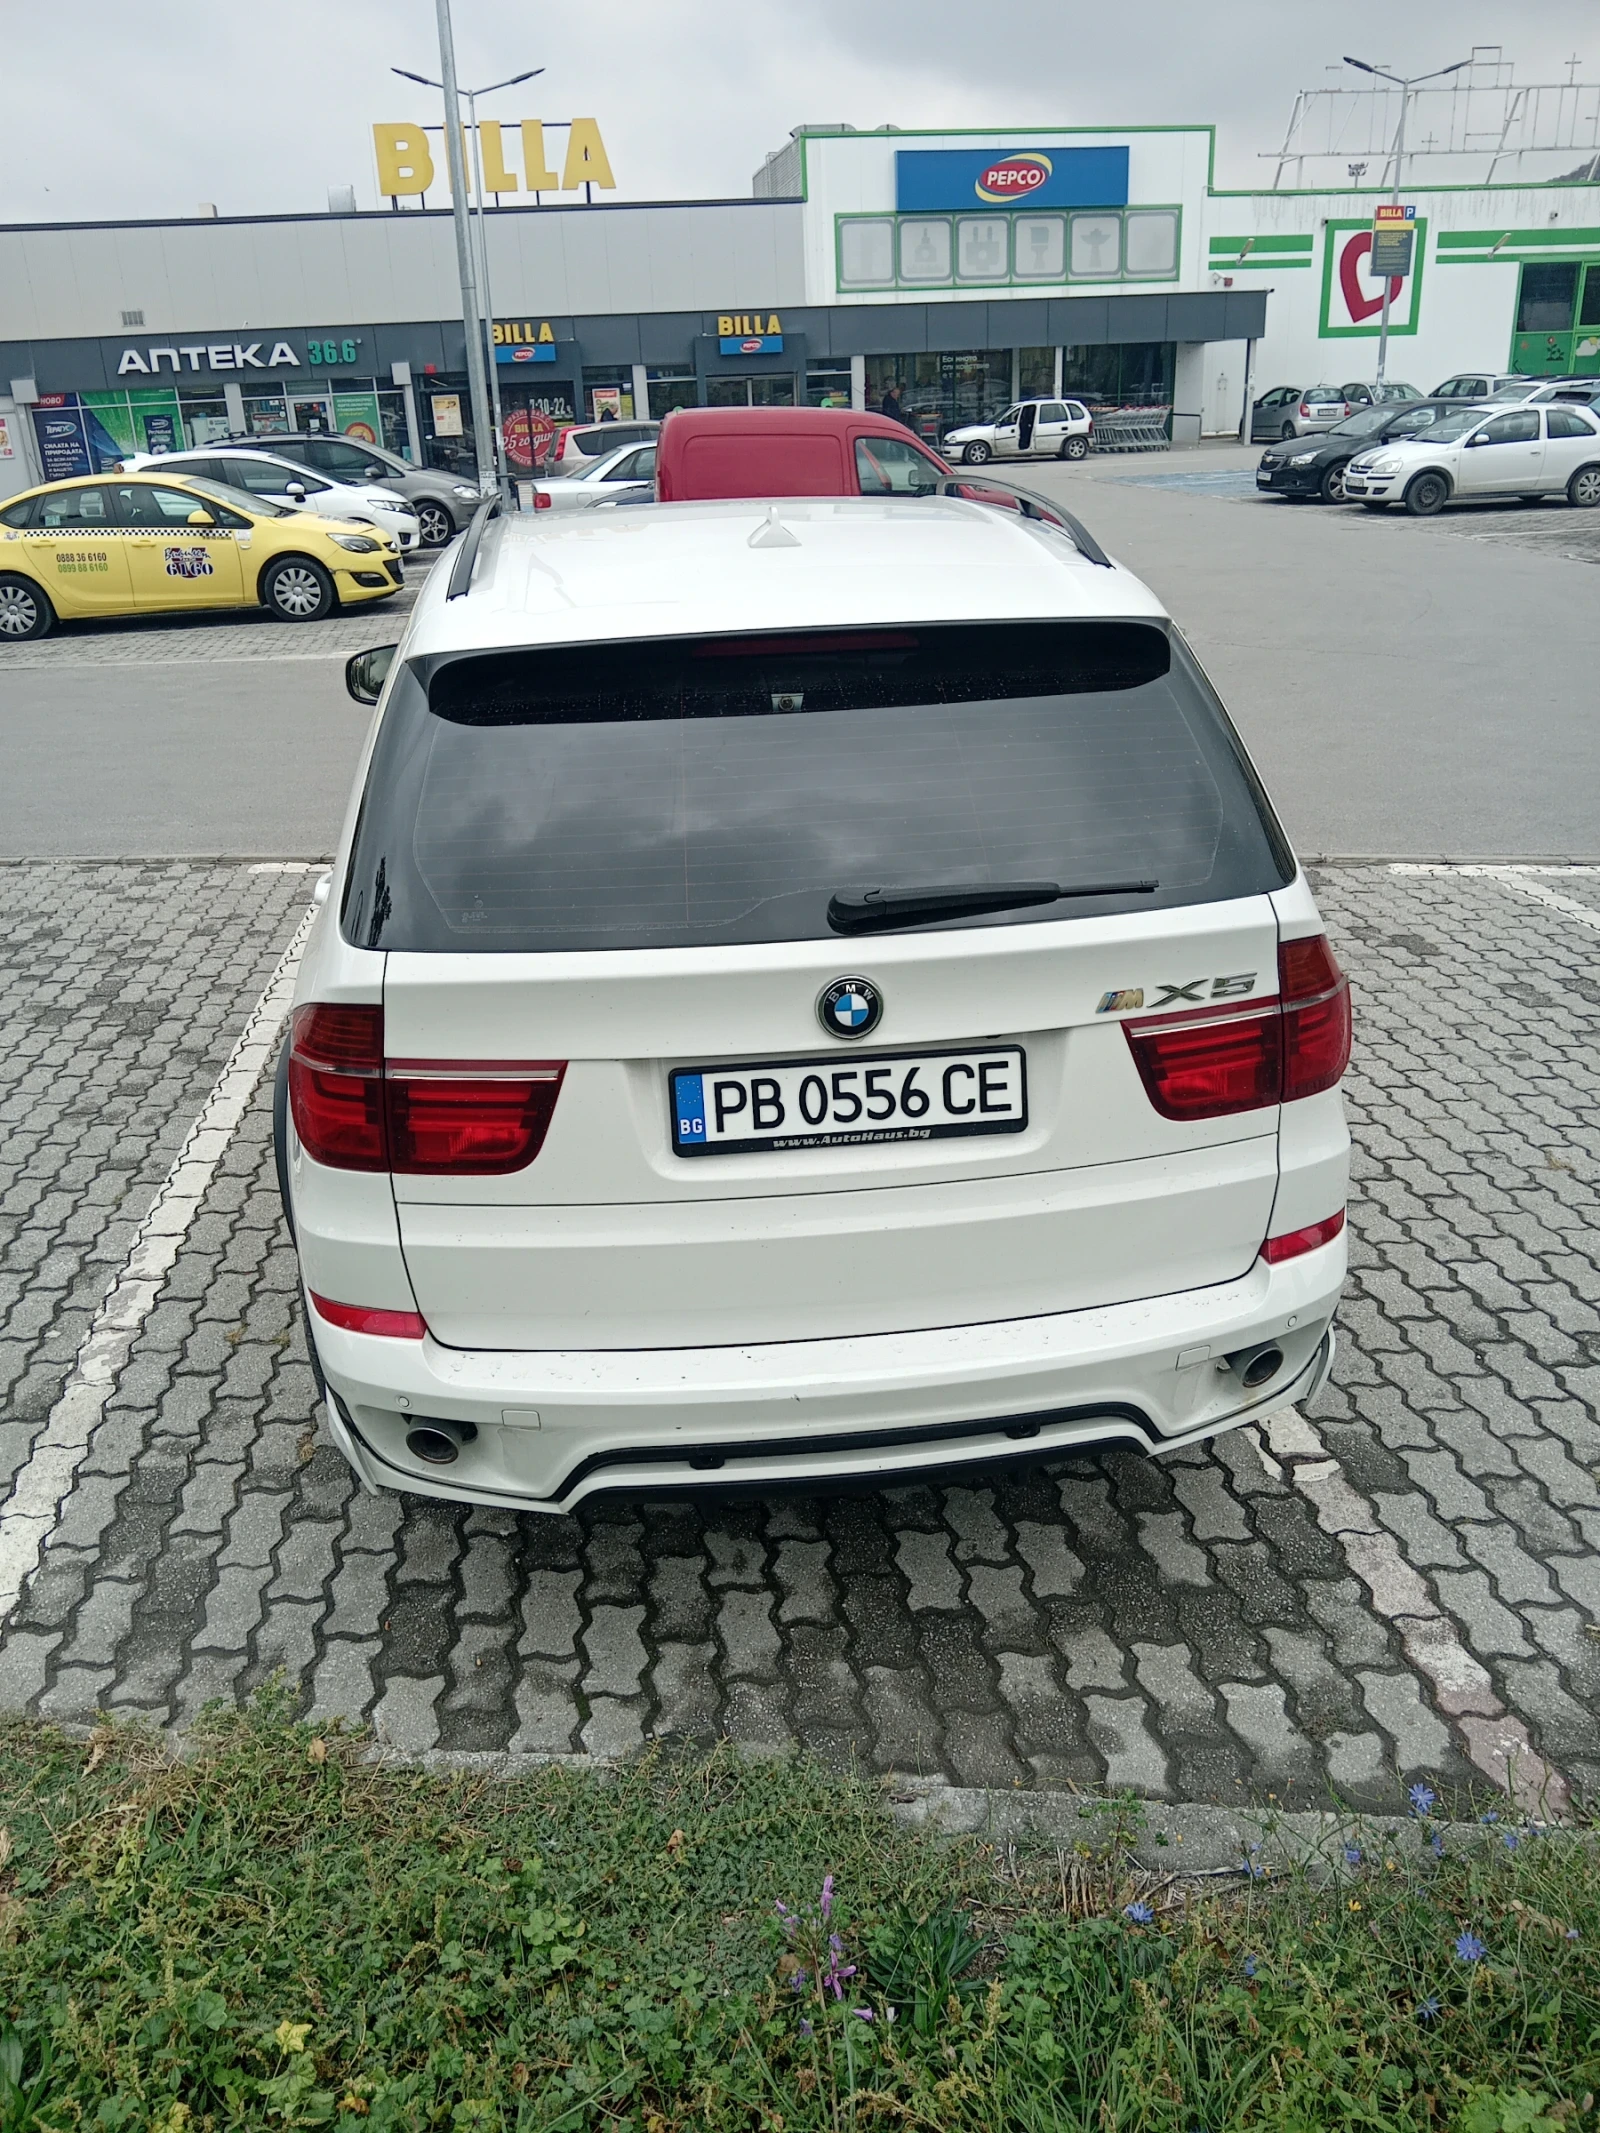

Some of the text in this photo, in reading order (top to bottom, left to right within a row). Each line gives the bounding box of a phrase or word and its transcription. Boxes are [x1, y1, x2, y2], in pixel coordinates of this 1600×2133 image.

[986, 169, 1041, 186] PEPCO
[1380, 207, 1414, 218] BILLA P
[492, 322, 554, 344] BILLA
[718, 314, 782, 336] BILLA
[117, 341, 301, 375] АПТЕКА
[40, 396, 62, 405] НОВО
[514, 423, 544, 433] BILLA
[56, 552, 107, 563] 0888 36 6160
[58, 563, 76, 573] 0899
[89, 563, 108, 572] 6160
[166, 562, 213, 575] 6160
[828, 984, 874, 1002] BMW
[680, 1117, 703, 1135] BG
[798, 1066, 931, 1126] 0556
[942, 1060, 1012, 1115] CE
[772, 1127, 931, 1149] www.AutoHaus.bg
